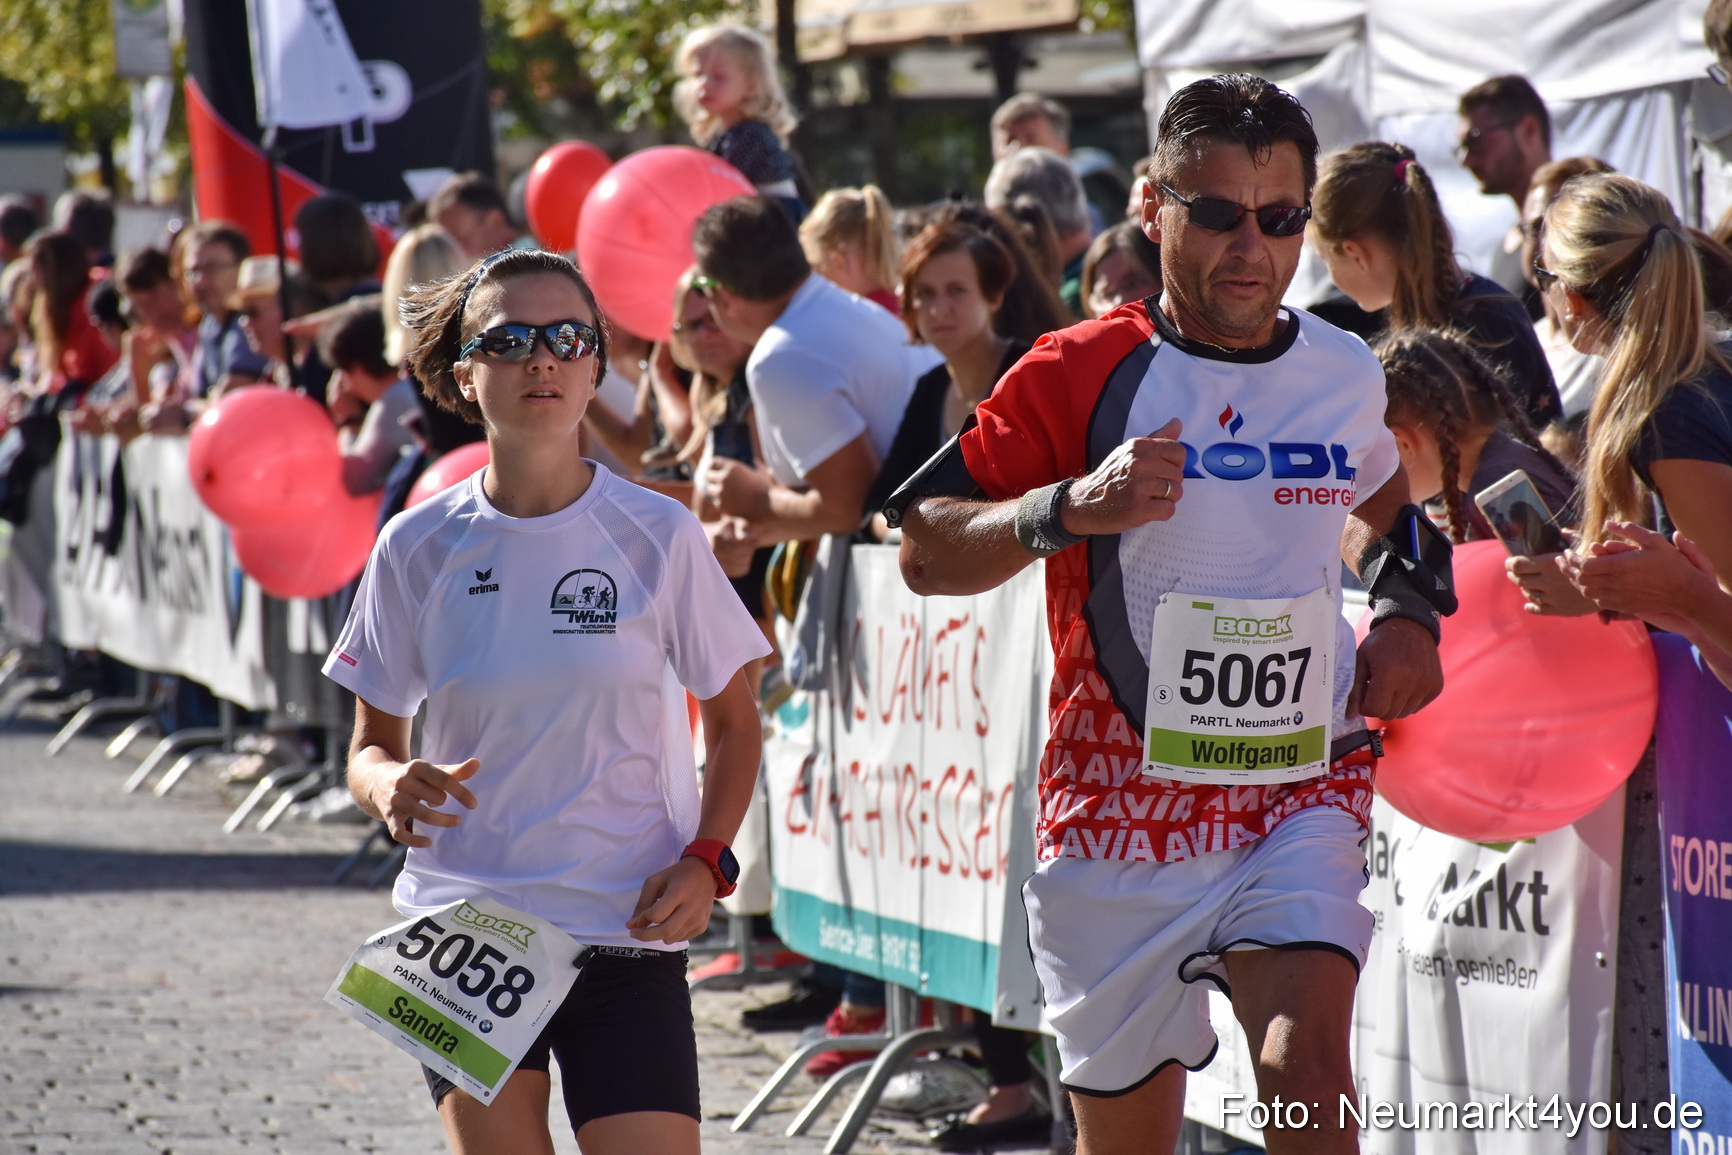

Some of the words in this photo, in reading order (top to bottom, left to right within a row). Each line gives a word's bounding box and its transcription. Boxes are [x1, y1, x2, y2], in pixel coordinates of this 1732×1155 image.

[468, 583, 499, 595] erima
[1213, 613, 1293, 638] BOCK
[1213, 635, 1240, 644] inspired
[1272, 635, 1293, 644] concepts
[1180, 646, 1312, 708] 5067
[1159, 689, 1167, 700] S
[1190, 714, 1233, 728] PARTL
[1236, 716, 1291, 728] Neumarkt
[1191, 739, 1299, 770] Wolfgang
[377, 934, 387, 946] S
[450, 916, 474, 930] inspired
[483, 929, 502, 939] smart
[501, 936, 527, 955] concepts
[454, 901, 536, 949] BOCK
[396, 916, 535, 1018] 5058
[598, 945, 643, 959] PEPPEX
[1456, 957, 1538, 990] genießen
[392, 964, 428, 993] PARTL
[429, 986, 478, 1024] Neumarkt
[388, 996, 459, 1054] Sandra
